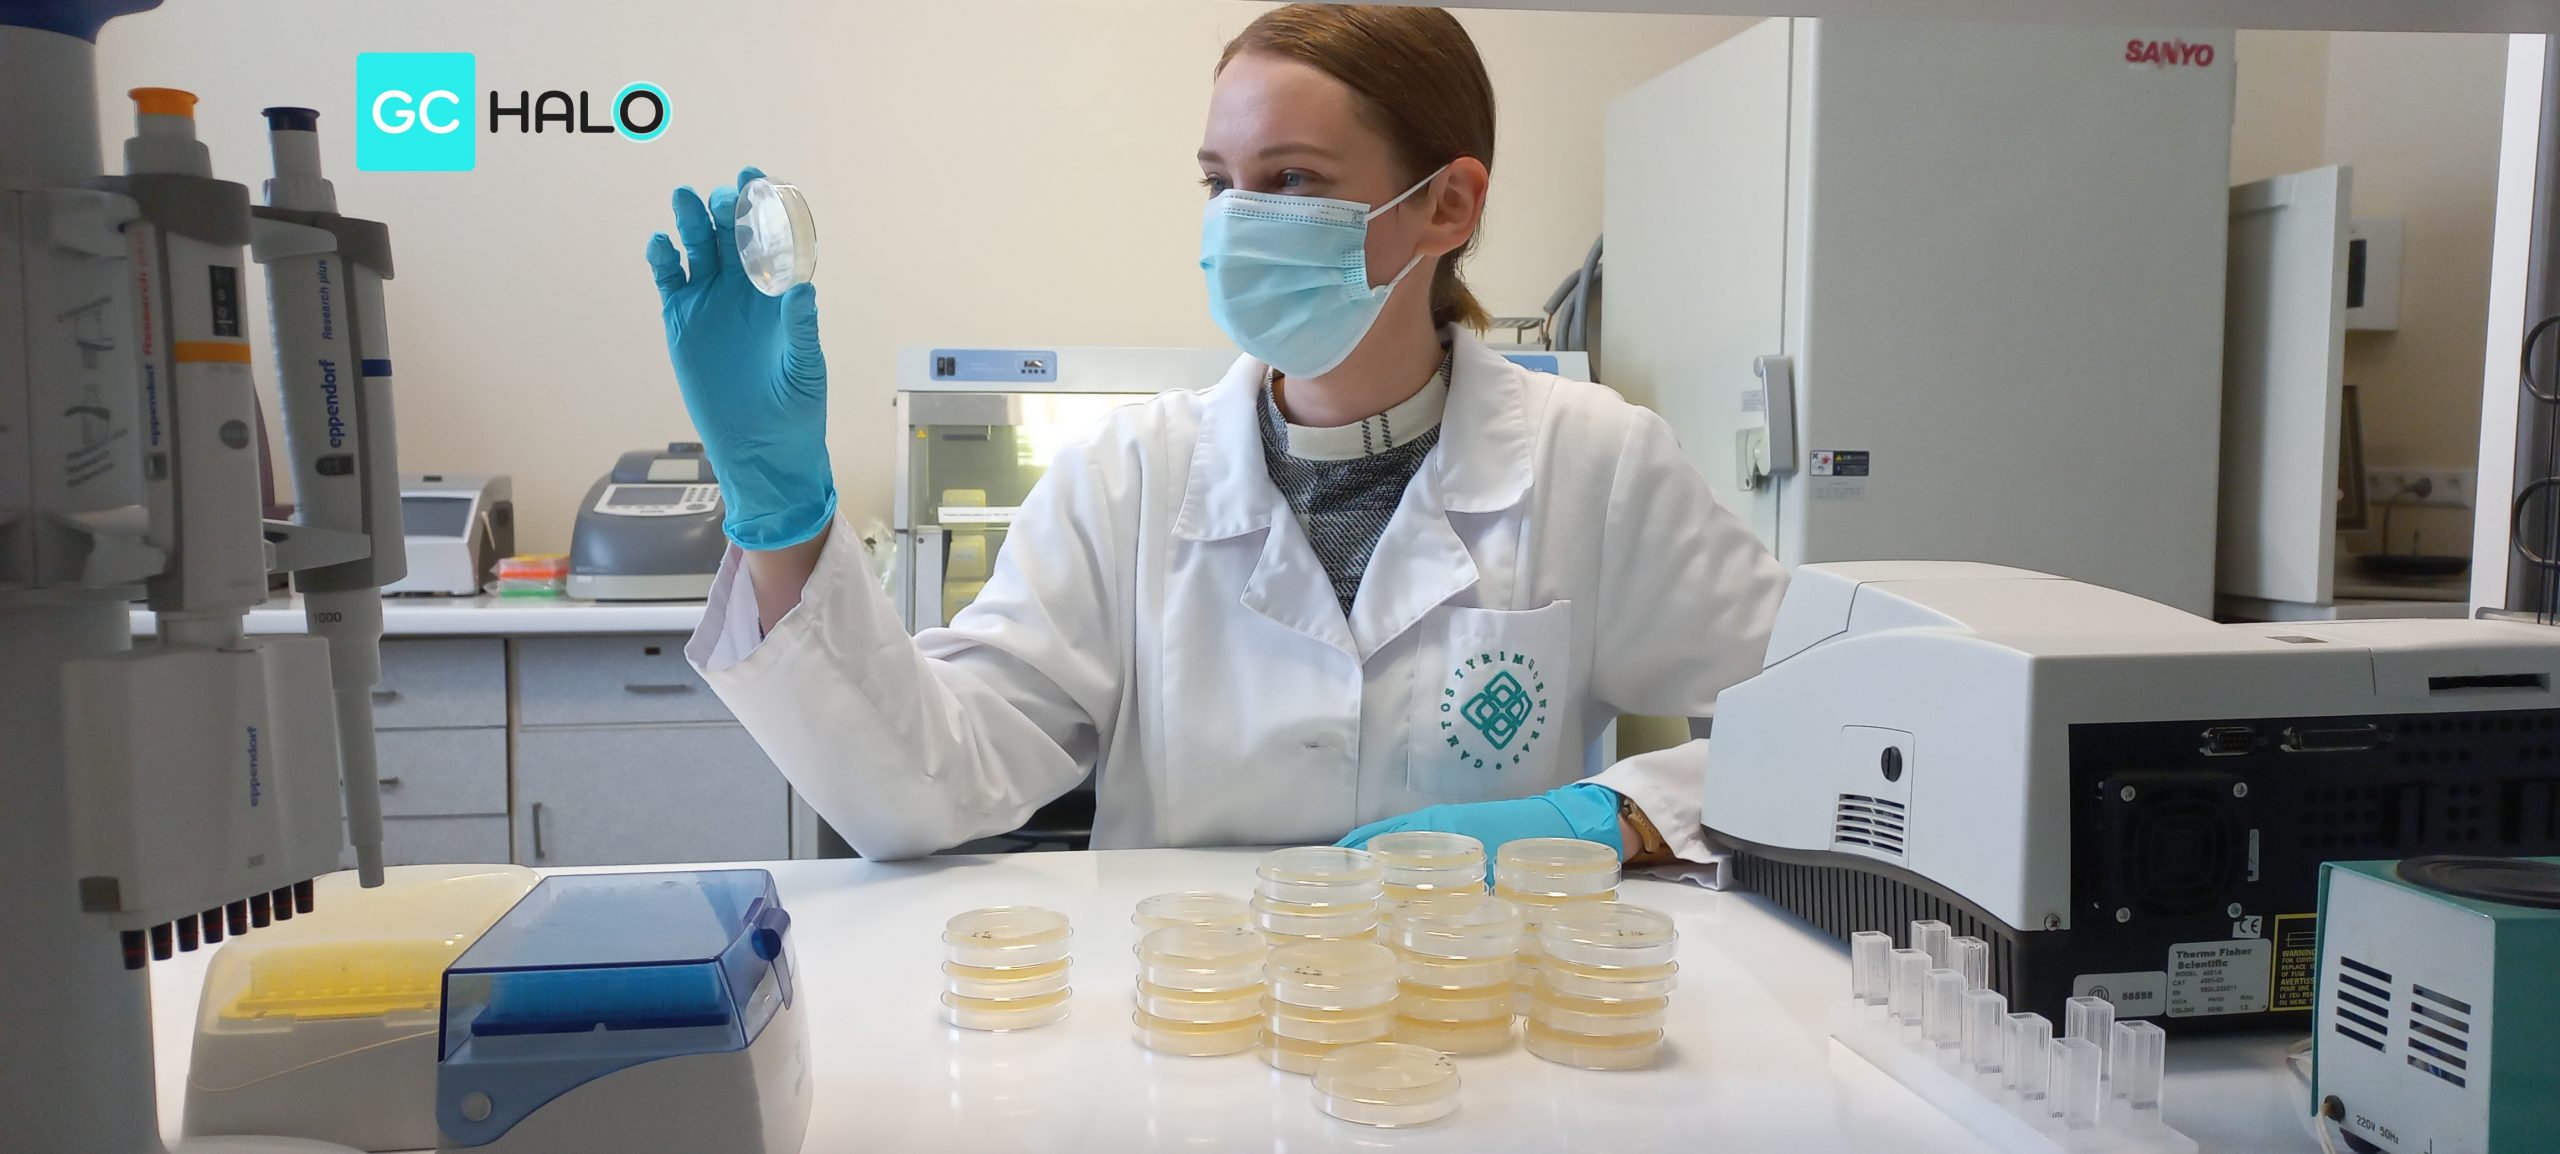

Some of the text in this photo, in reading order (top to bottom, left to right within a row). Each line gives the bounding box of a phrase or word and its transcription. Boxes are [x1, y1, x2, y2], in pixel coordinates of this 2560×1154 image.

[2125, 38, 2215, 67] SANYO
[318, 259, 331, 285] plus
[319, 286, 333, 340] Research
[318, 359, 345, 448] eppendorf
[313, 611, 342, 623] 1000
[247, 726, 260, 807] eppendorf
[2176, 948, 2253, 959] Thermo Fisher
[2177, 959, 2228, 969] Scientific
[2356, 1114, 2399, 1144] 220V 50Hz
